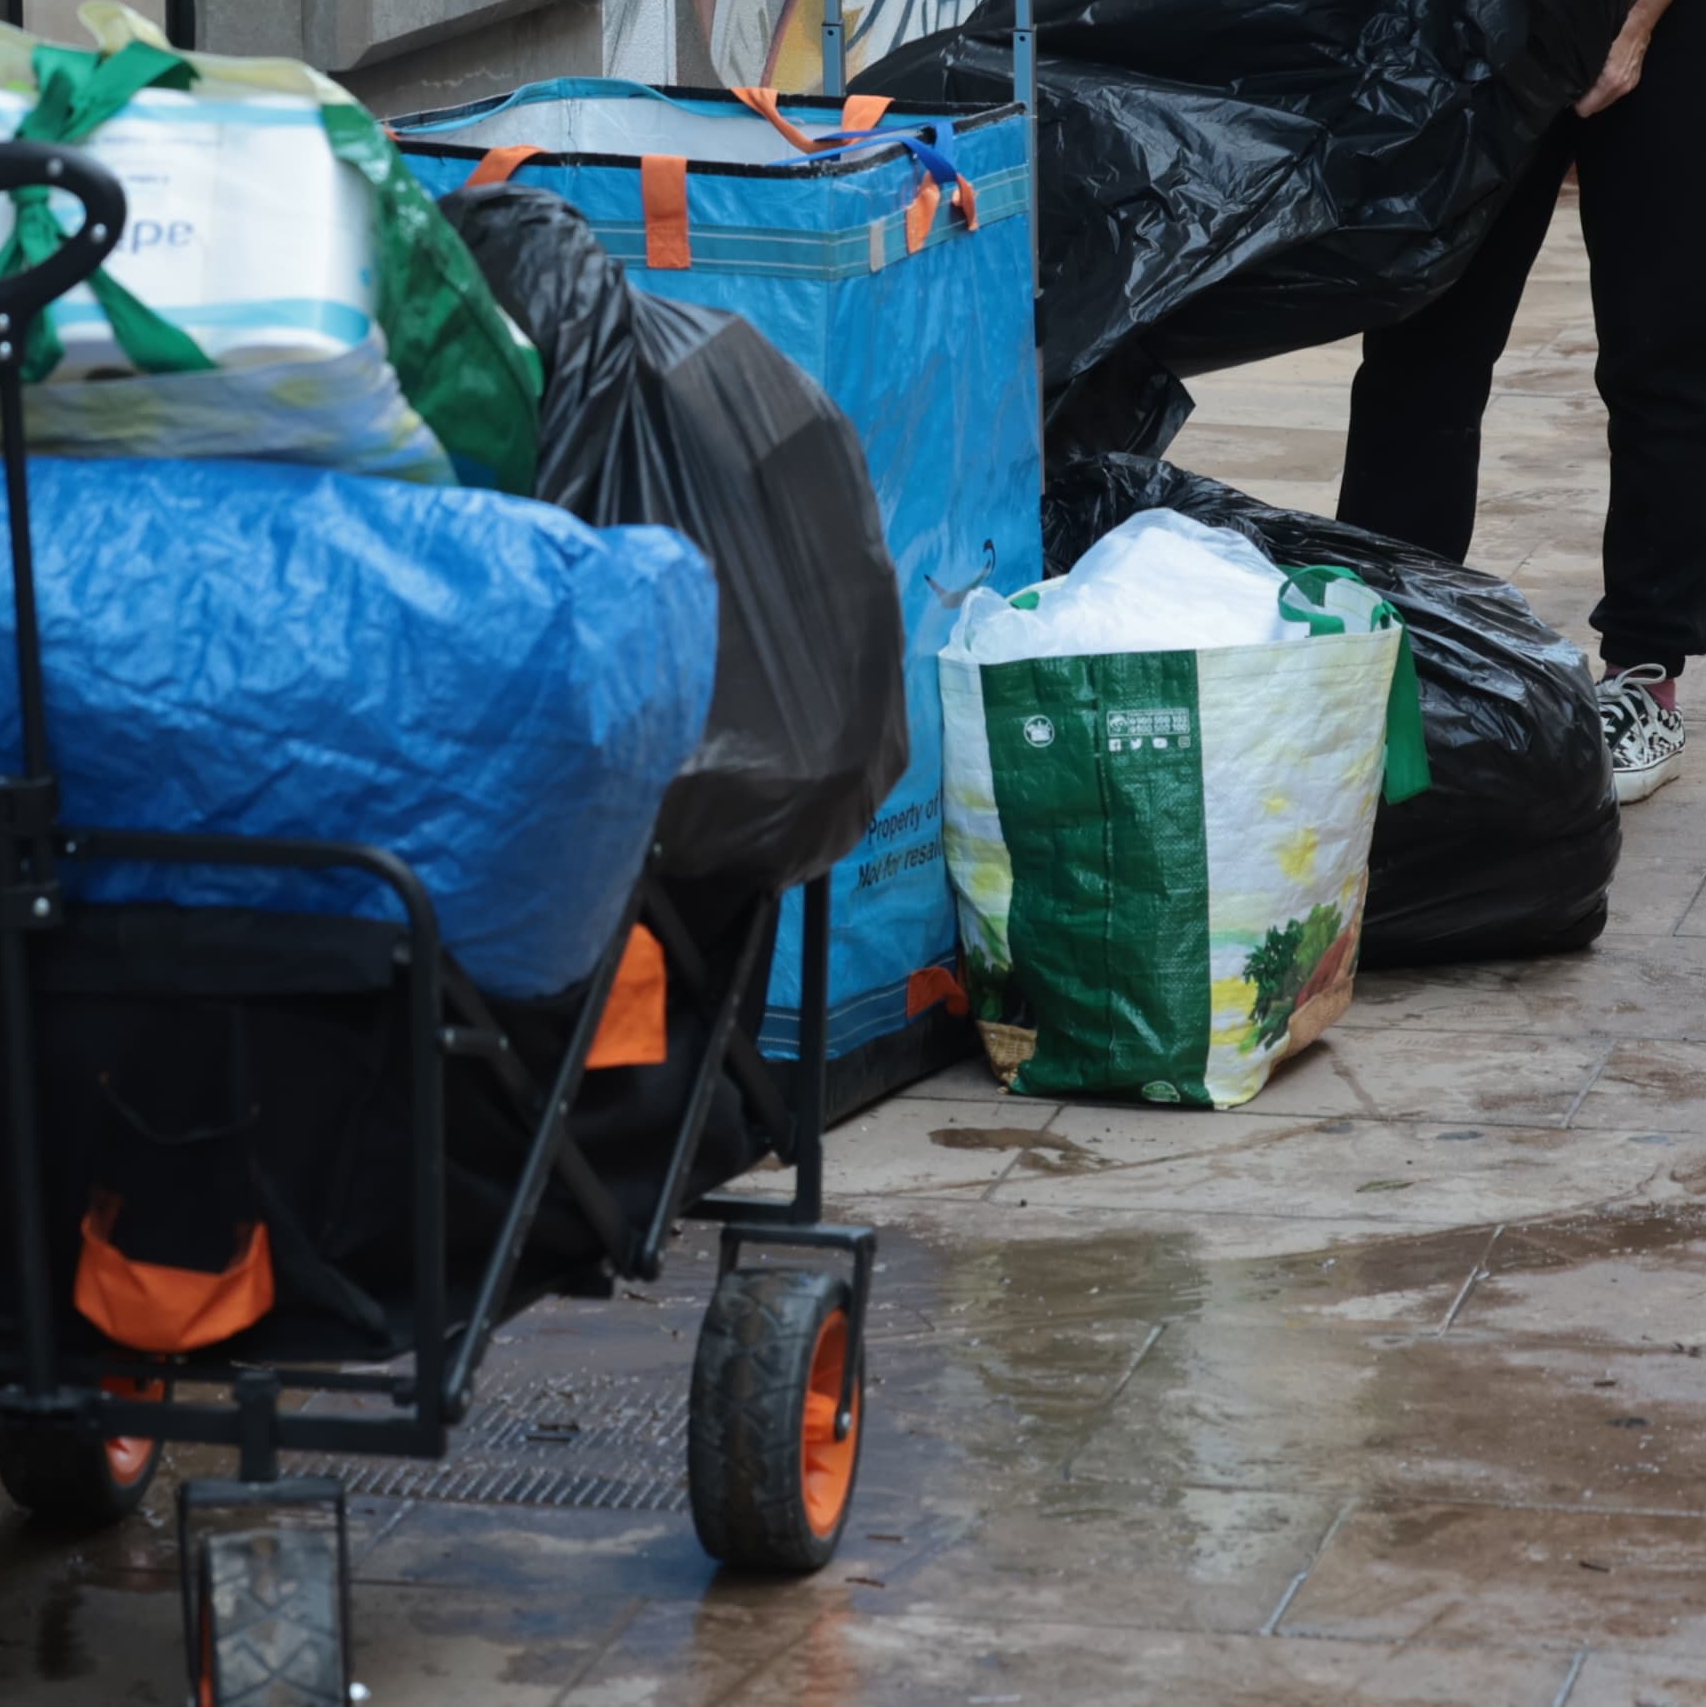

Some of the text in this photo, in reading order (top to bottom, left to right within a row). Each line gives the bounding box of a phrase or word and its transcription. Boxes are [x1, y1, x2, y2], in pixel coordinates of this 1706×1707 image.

[867, 802, 924, 846] Property
[858, 834, 943, 887] Not for resal
